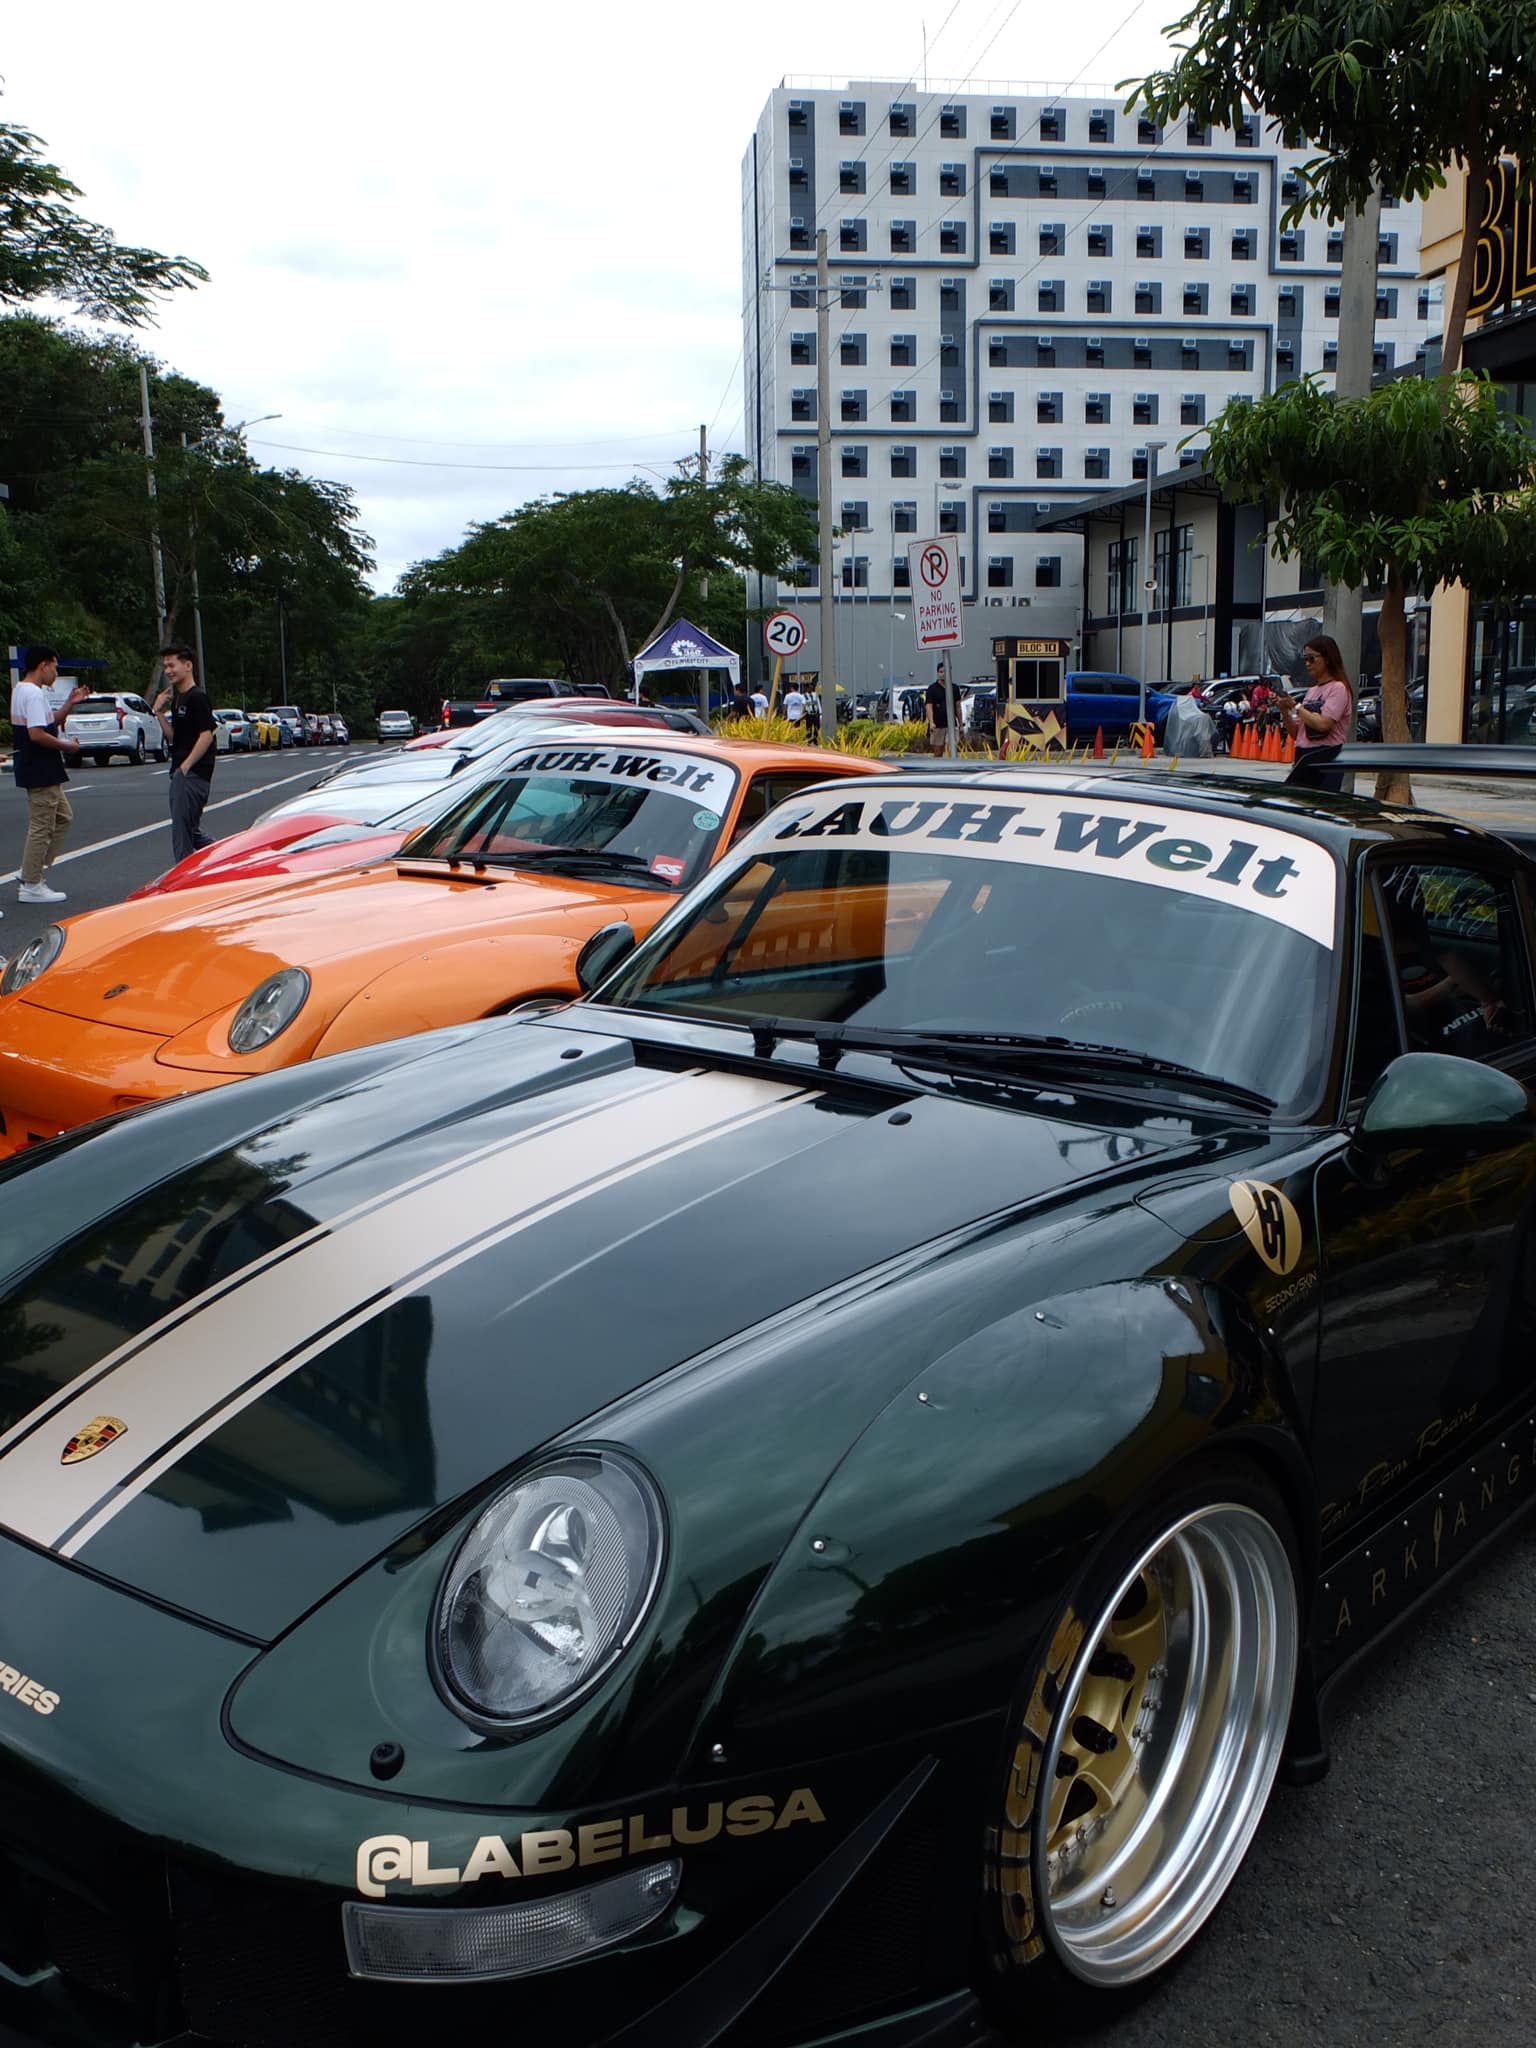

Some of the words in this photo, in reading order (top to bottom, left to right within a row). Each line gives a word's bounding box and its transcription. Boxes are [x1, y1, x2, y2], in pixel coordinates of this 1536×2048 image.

[930, 590, 943, 602] NO
[919, 602, 956, 618] PARKING
[919, 616, 958, 633] ANYTIME
[769, 621, 801, 647] 20
[1020, 643, 1042, 653] BLOC
[0, 1660, 61, 1716] RIES
[355, 1787, 827, 1898] @LABELUSA
